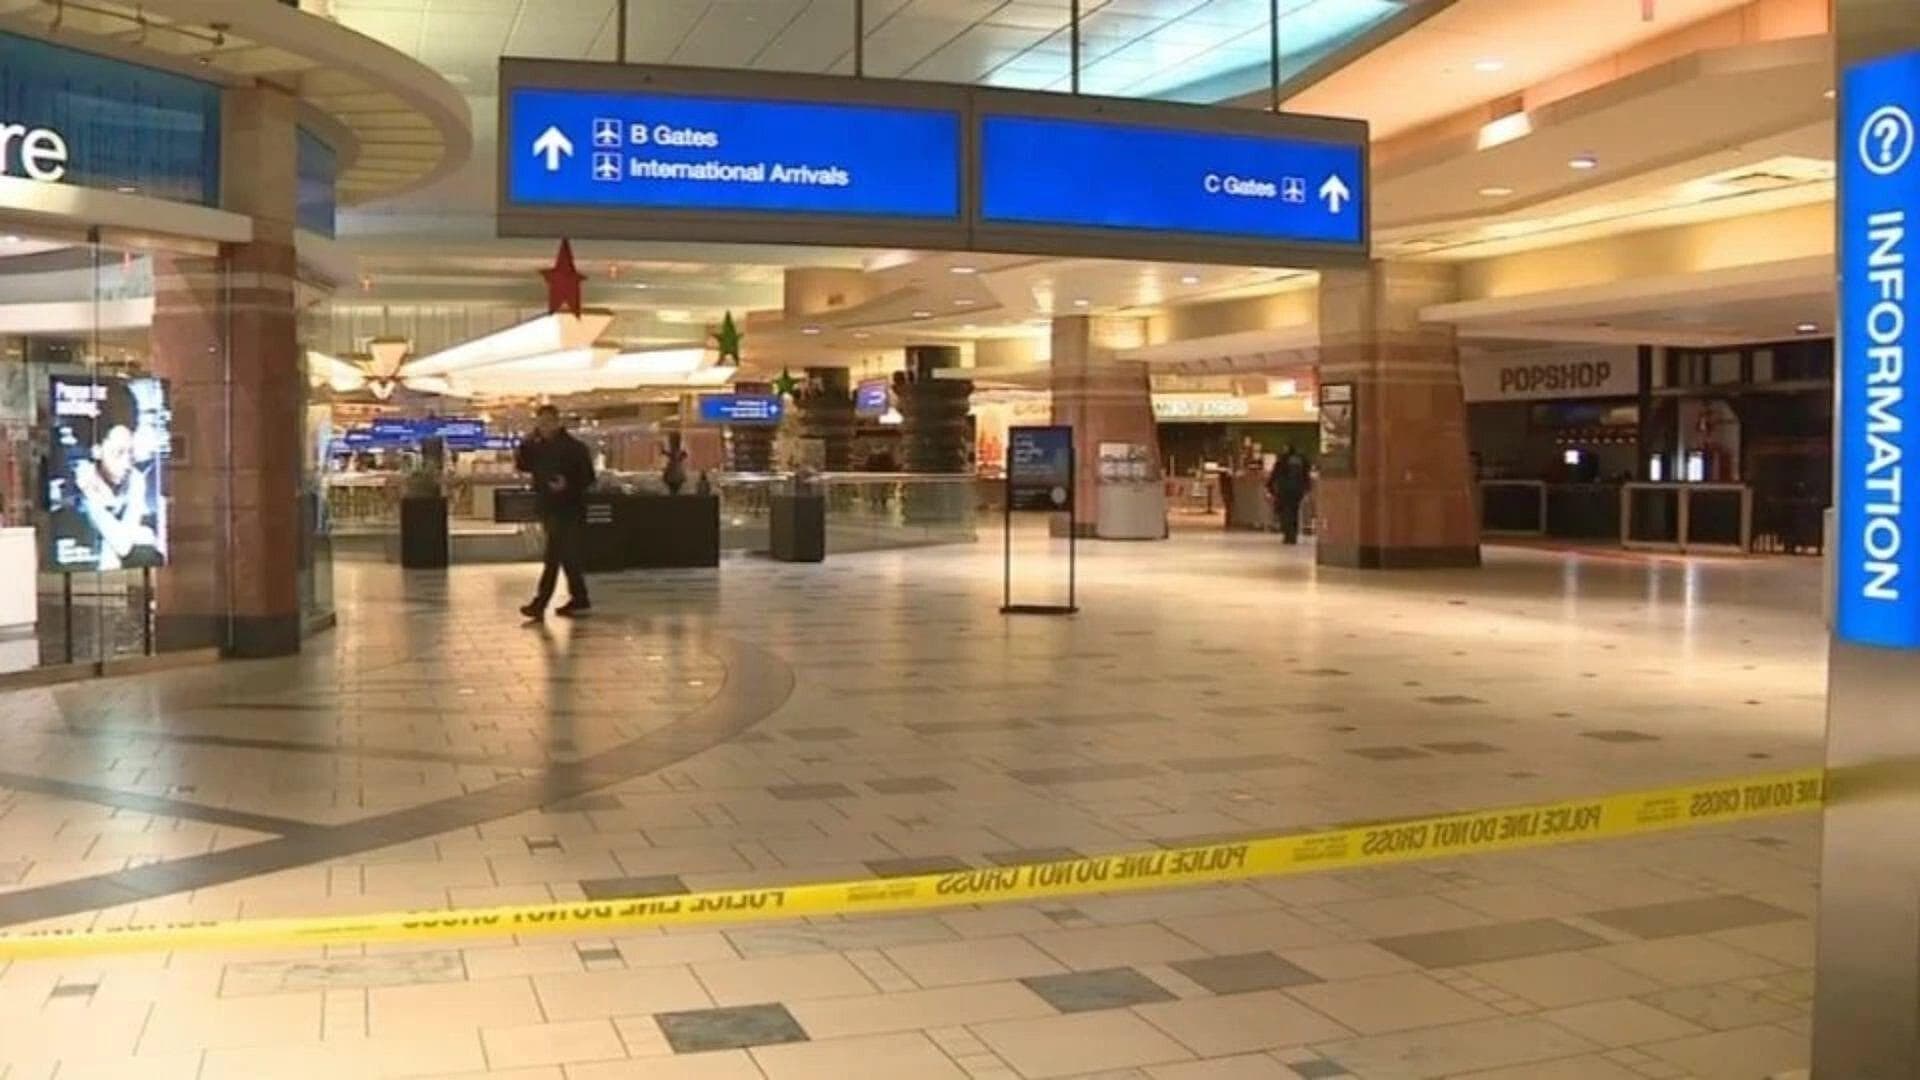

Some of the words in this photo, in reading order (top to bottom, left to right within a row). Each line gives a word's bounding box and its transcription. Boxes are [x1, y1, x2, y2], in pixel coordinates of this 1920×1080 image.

[630, 124, 648, 144] B
[653, 126, 719, 147] Gates
[0, 123, 68, 180] re
[630, 158, 765, 182] International
[769, 163, 849, 186] Arrivals
[1204, 174, 1221, 193] C
[1224, 176, 1276, 198] Gates
[1501, 361, 1611, 393] POPSHOP
[1863, 210, 1905, 600] INFORMATION
